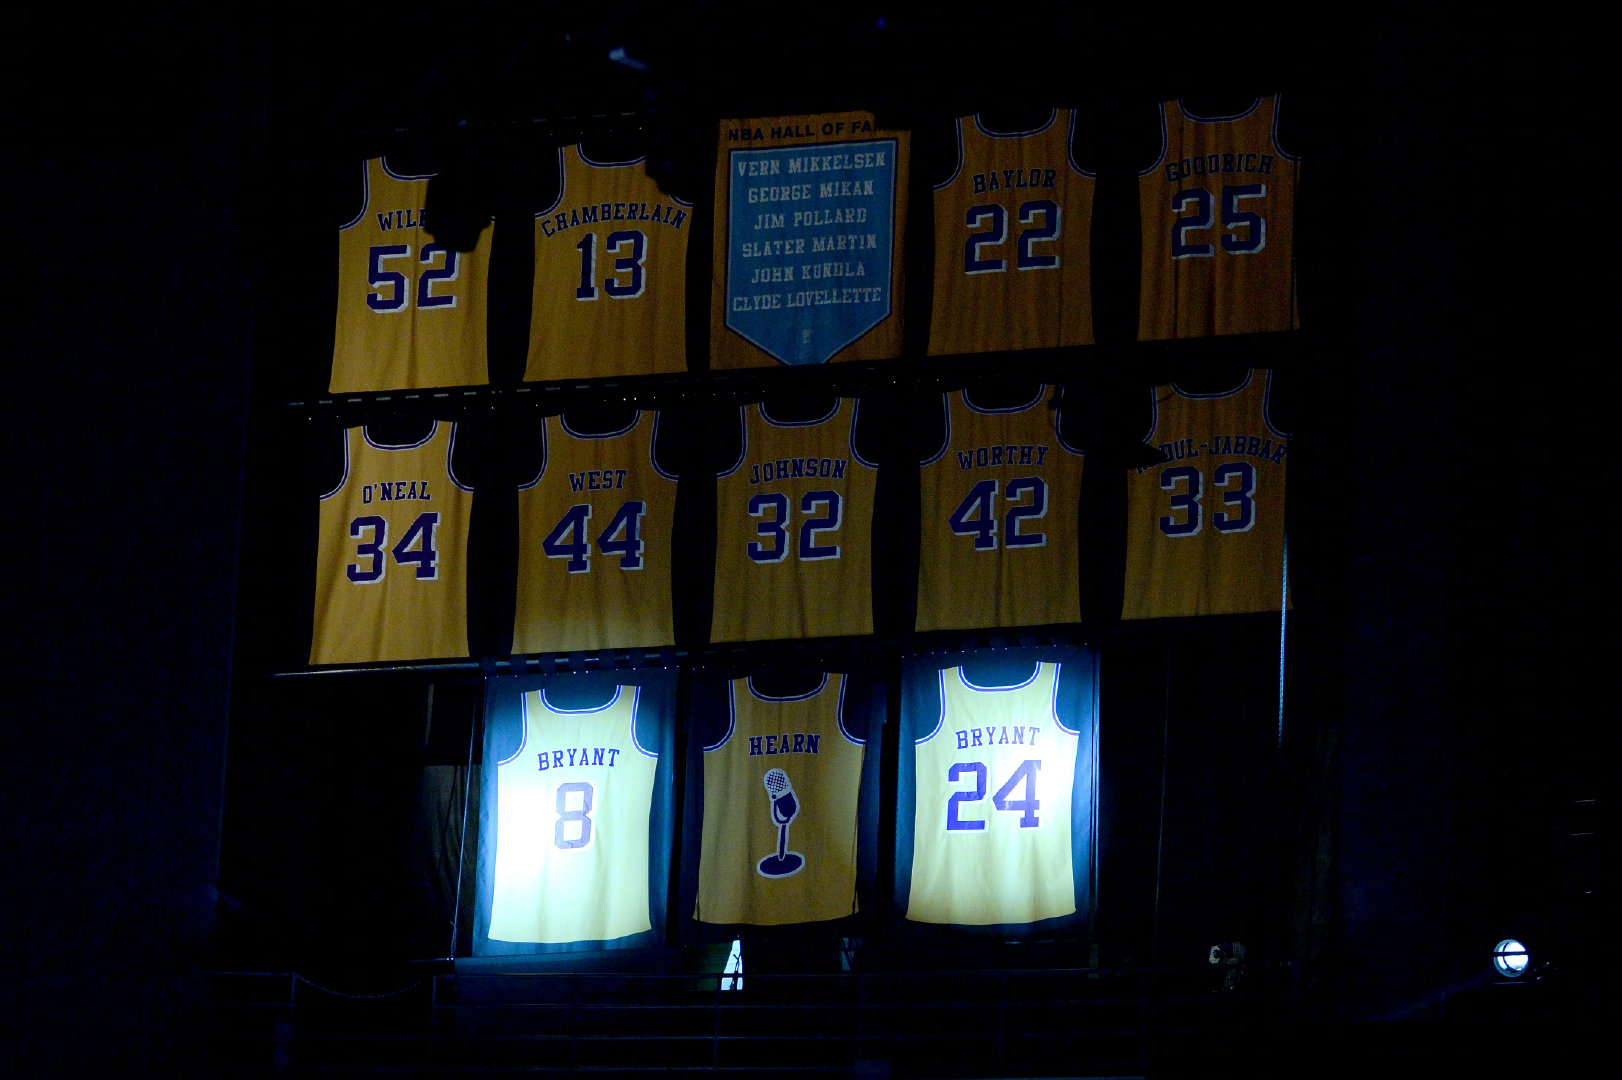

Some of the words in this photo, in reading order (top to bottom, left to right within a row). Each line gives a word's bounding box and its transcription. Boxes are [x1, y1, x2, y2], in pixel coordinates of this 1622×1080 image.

[728, 126, 764, 141] NBA
[770, 124, 814, 140] HALL
[822, 121, 844, 136] OF
[851, 119, 888, 133] FA
[737, 159, 781, 177] VERN
[788, 152, 886, 174] MIKKELSEN
[1164, 153, 1275, 182] GOODRICH
[748, 184, 812, 204] GEORGE
[819, 180, 874, 198] MIKAN
[973, 168, 1057, 194] BAYLOR
[540, 202, 688, 239] CHAMBERLAIN
[754, 213, 785, 230] JIM
[793, 207, 867, 227] POLLARD
[1171, 183, 1267, 260] 25
[742, 238, 805, 258] SLATER
[812, 234, 877, 253] MARTIN
[964, 199, 1062, 275] 22
[366, 243, 460, 313] 52
[576, 230, 648, 301] 13
[751, 266, 794, 284] JOHN
[801, 261, 865, 280] KUNDLA
[733, 293, 782, 312] CLYDE
[787, 287, 882, 307] LOVELLETTE
[750, 457, 847, 485] JOHNSON
[957, 445, 1048, 470] WORTHY
[362, 481, 431, 504] O'NEAL
[568, 469, 627, 492] WEST
[1159, 461, 1257, 538] 33
[747, 490, 843, 564] 32
[948, 476, 1049, 551] 42
[346, 512, 441, 586] 34
[542, 501, 647, 574] 44
[748, 733, 821, 757] HEARN
[955, 725, 1040, 750] BRYANT
[537, 747, 620, 772] BRYANT
[946, 759, 1042, 833] 24
[554, 780, 595, 850] 8
